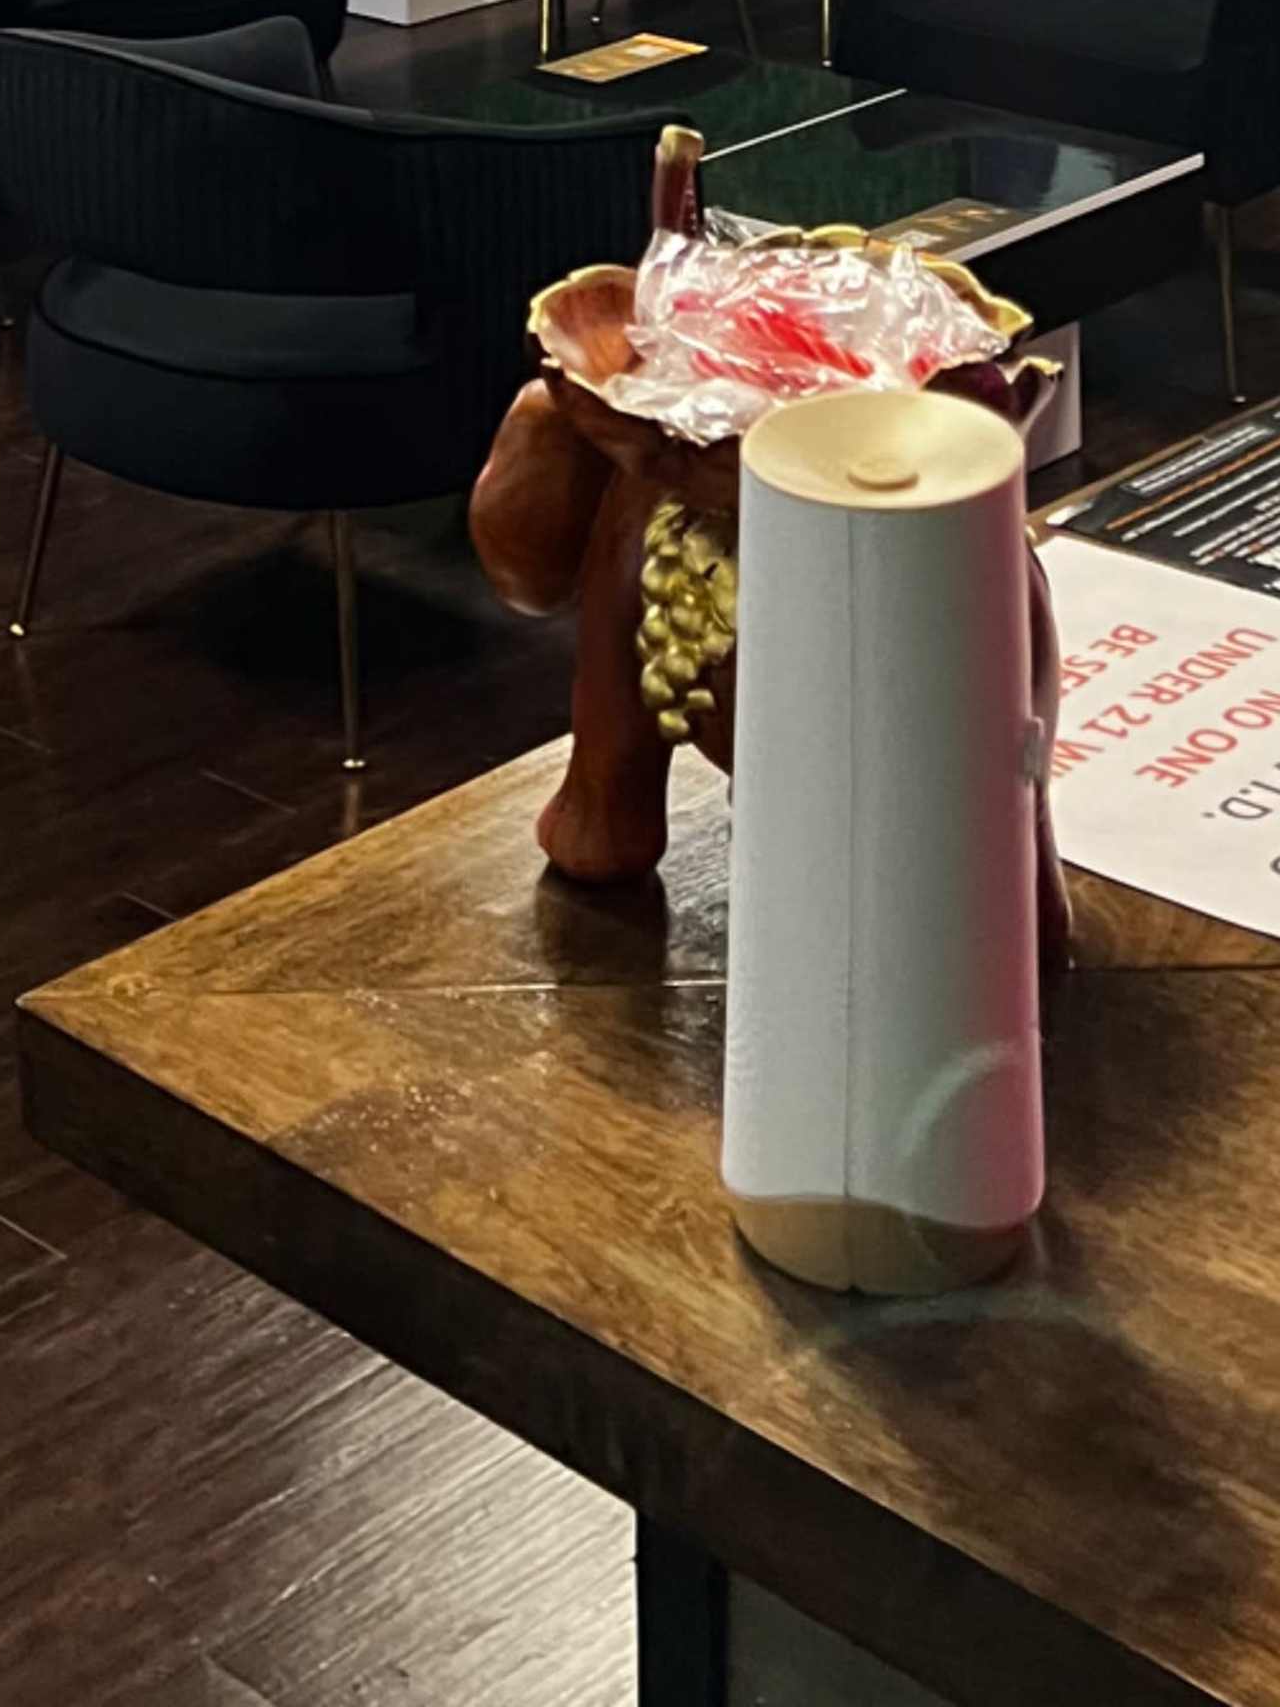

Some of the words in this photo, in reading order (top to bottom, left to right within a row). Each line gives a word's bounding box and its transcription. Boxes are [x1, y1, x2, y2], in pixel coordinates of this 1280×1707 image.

[1088, 623, 1159, 658] BE
[1059, 654, 1108, 698] SE
[1127, 627, 1279, 706] UNDER
[1079, 703, 1152, 740] 21
[1133, 728, 1239, 788] ONE
